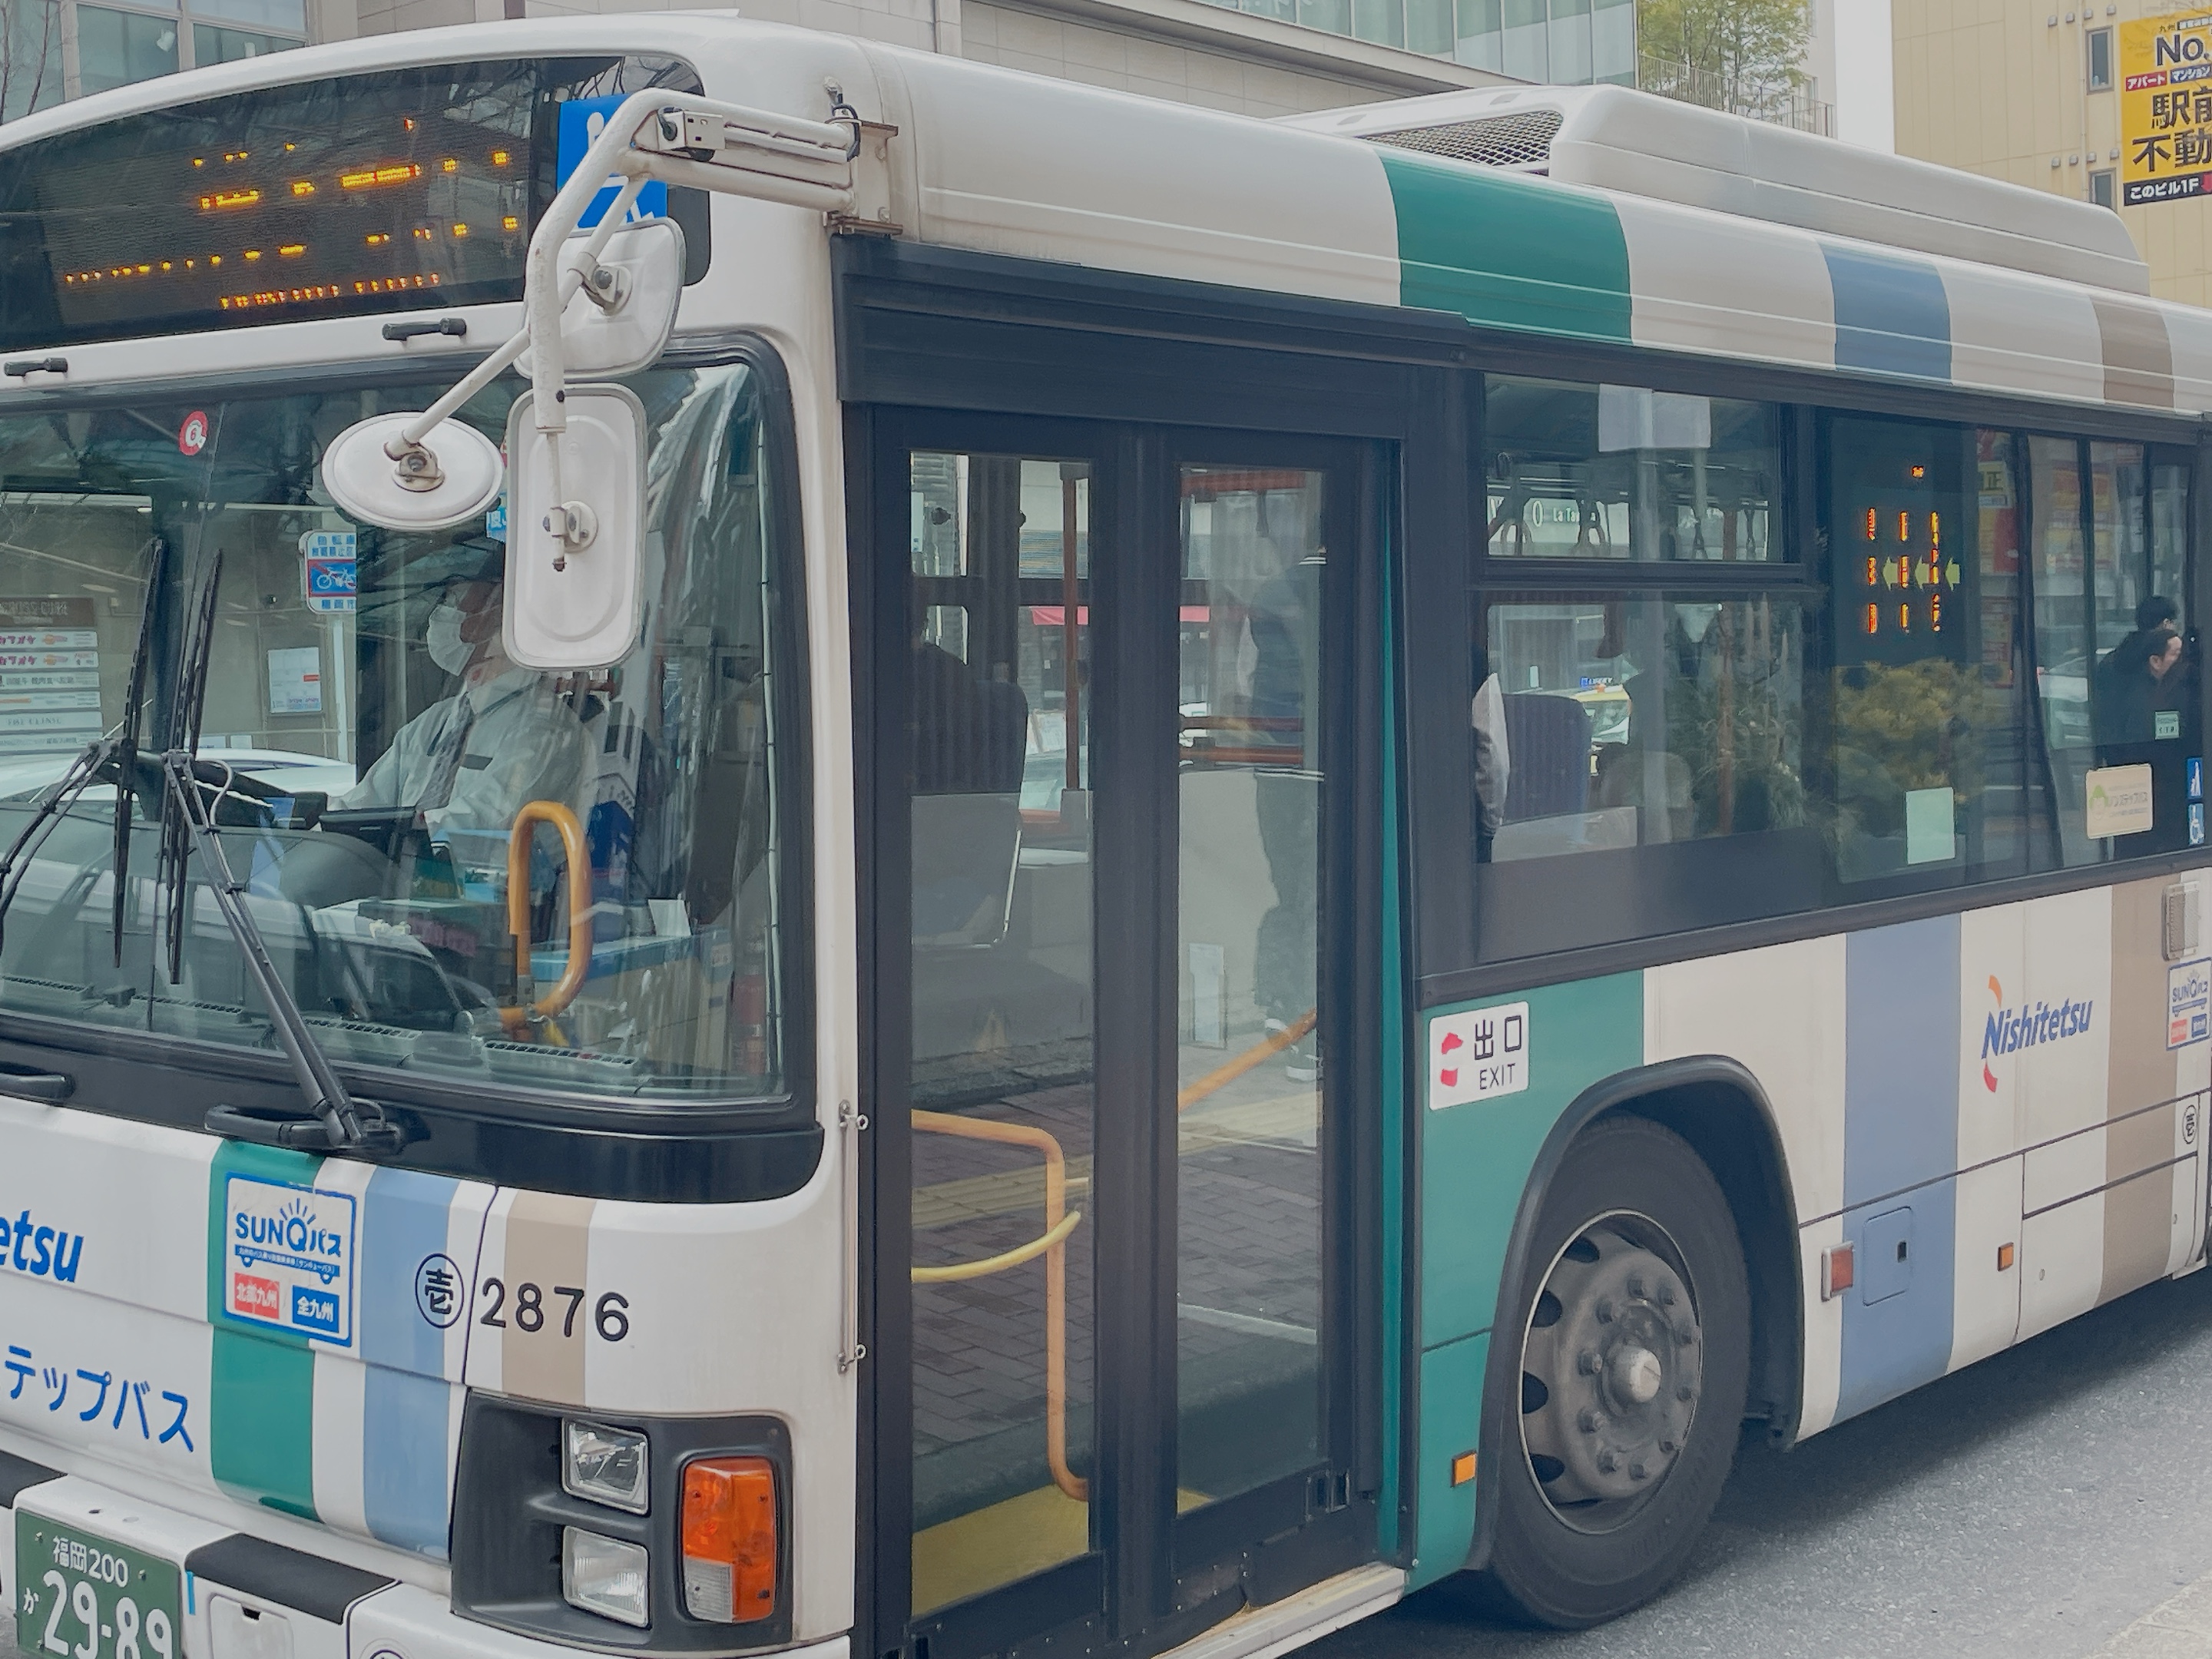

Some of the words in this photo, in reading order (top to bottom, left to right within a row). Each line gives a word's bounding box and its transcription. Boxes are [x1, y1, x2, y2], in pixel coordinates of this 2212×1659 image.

[2127, 73, 2166, 90] アパート
[2131, 127, 2212, 173] 不動
[2130, 177, 2199, 200] このビル1F
[1474, 1015, 1522, 1061] 出口
[1981, 998, 2094, 1060] Nishitetsu
[1479, 1062, 1516, 1091] EXIT
[296, 1295, 334, 1323] 全九州
[479, 1276, 630, 1343] 2876
[5, 1345, 194, 1453] テップバス
